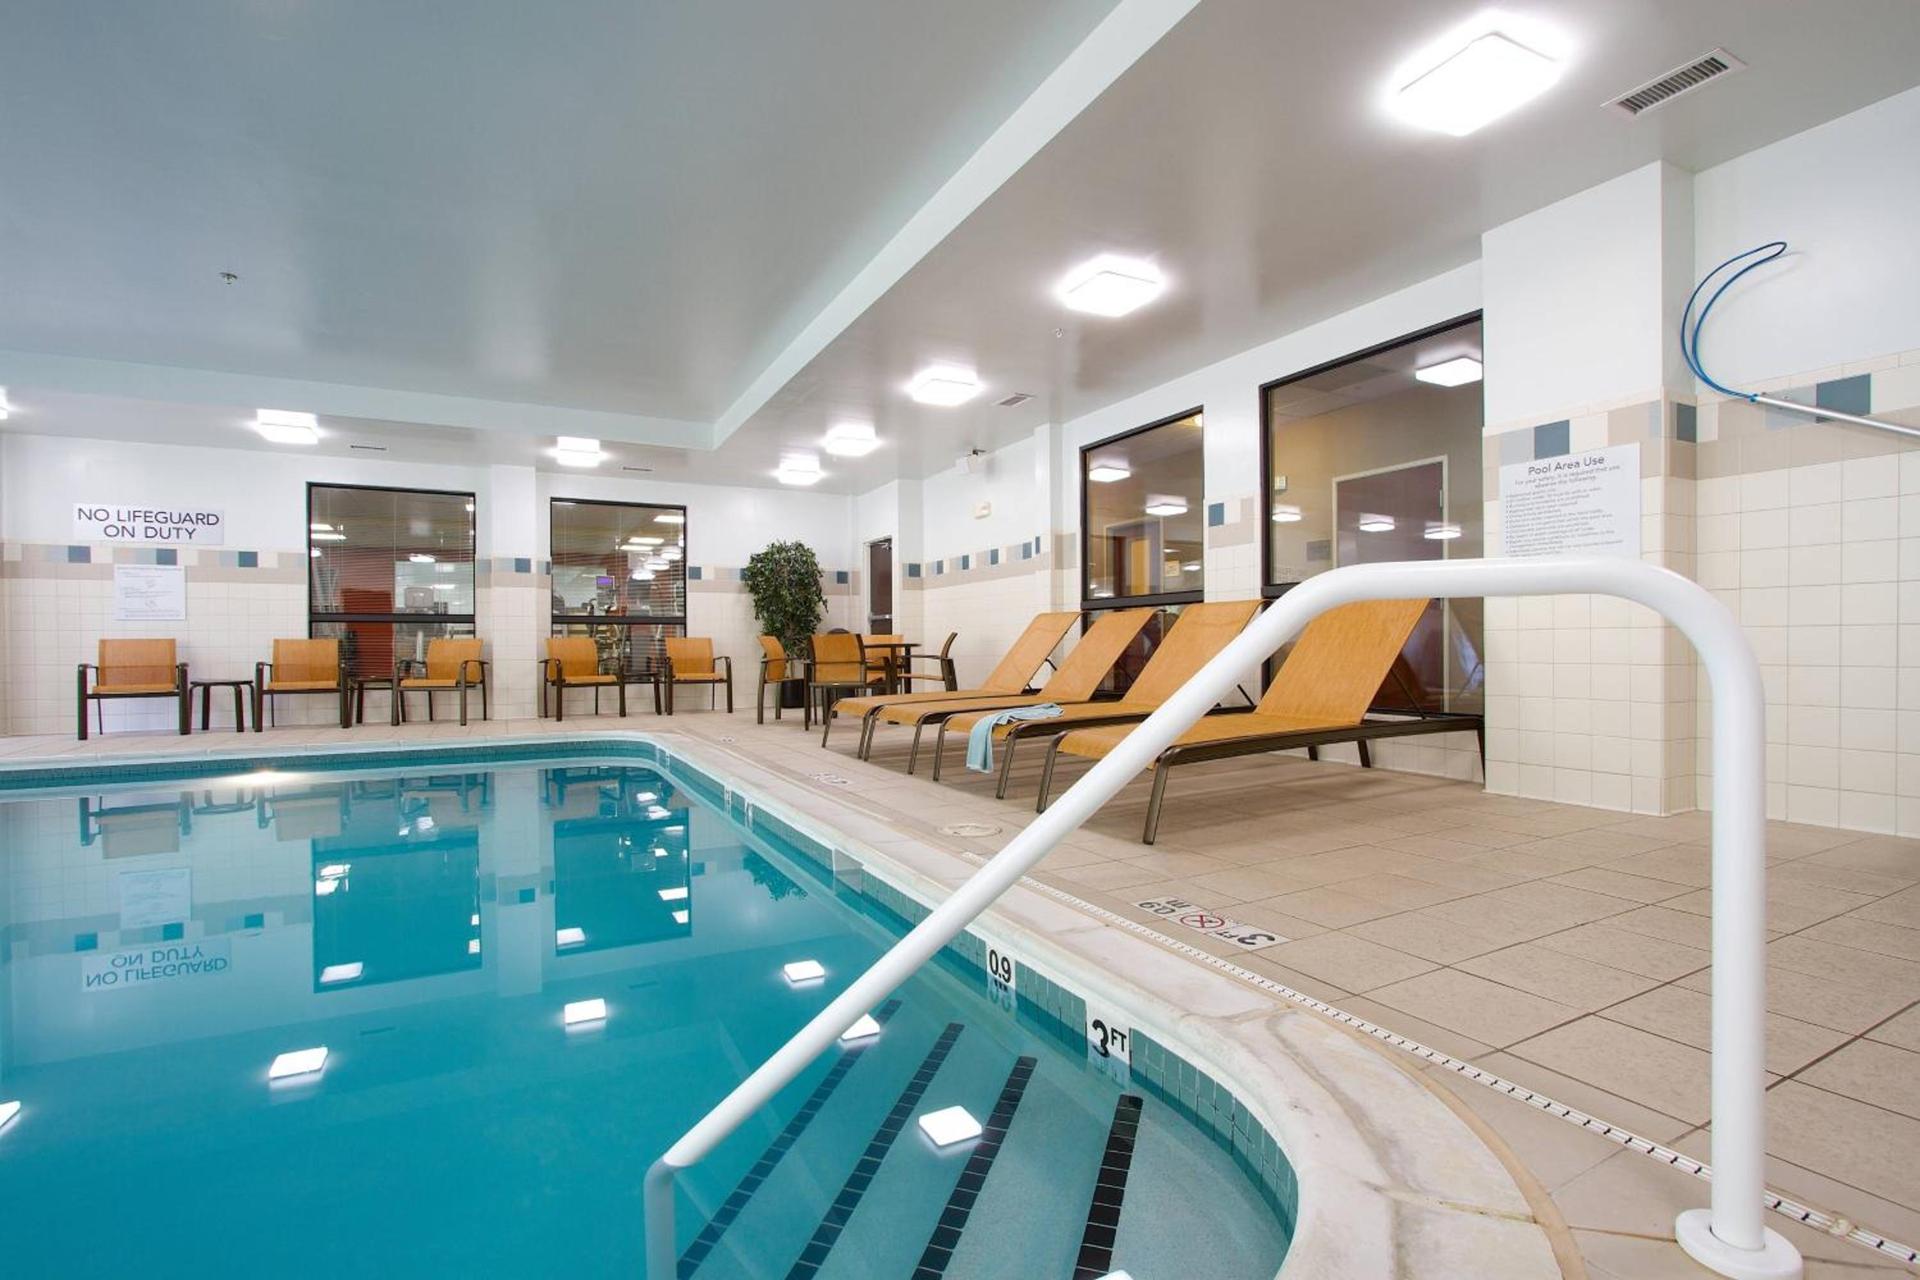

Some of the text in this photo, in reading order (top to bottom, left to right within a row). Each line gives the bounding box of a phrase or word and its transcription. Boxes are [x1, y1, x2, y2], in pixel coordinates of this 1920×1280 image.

[1528, 457, 1605, 476] Pool Area Use
[78, 508, 220, 526] NO LIFEGUARD
[104, 524, 197, 540] ON DUTY
[1237, 933, 1276, 945] 3
[989, 949, 1011, 983] 0.9
